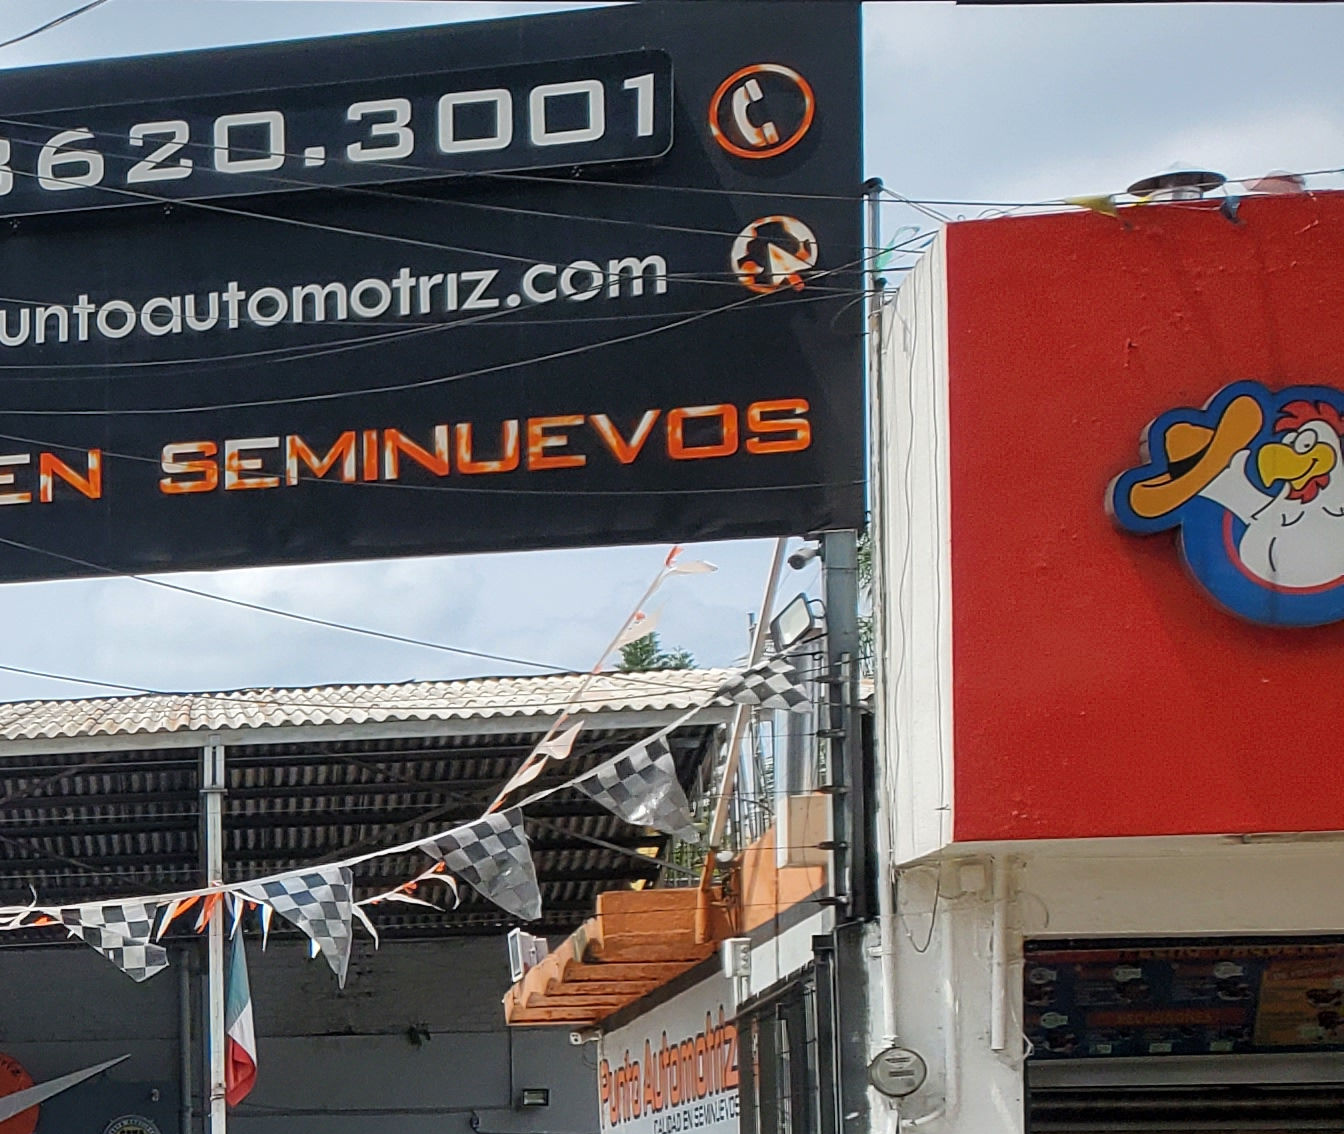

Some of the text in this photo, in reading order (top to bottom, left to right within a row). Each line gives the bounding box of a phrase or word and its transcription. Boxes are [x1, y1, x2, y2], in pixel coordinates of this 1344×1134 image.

[158, 397, 812, 495] SEMINUEVOS
[599, 1003, 740, 1130] Punto Automotriz
[683, 1109, 693, 1130] EN
